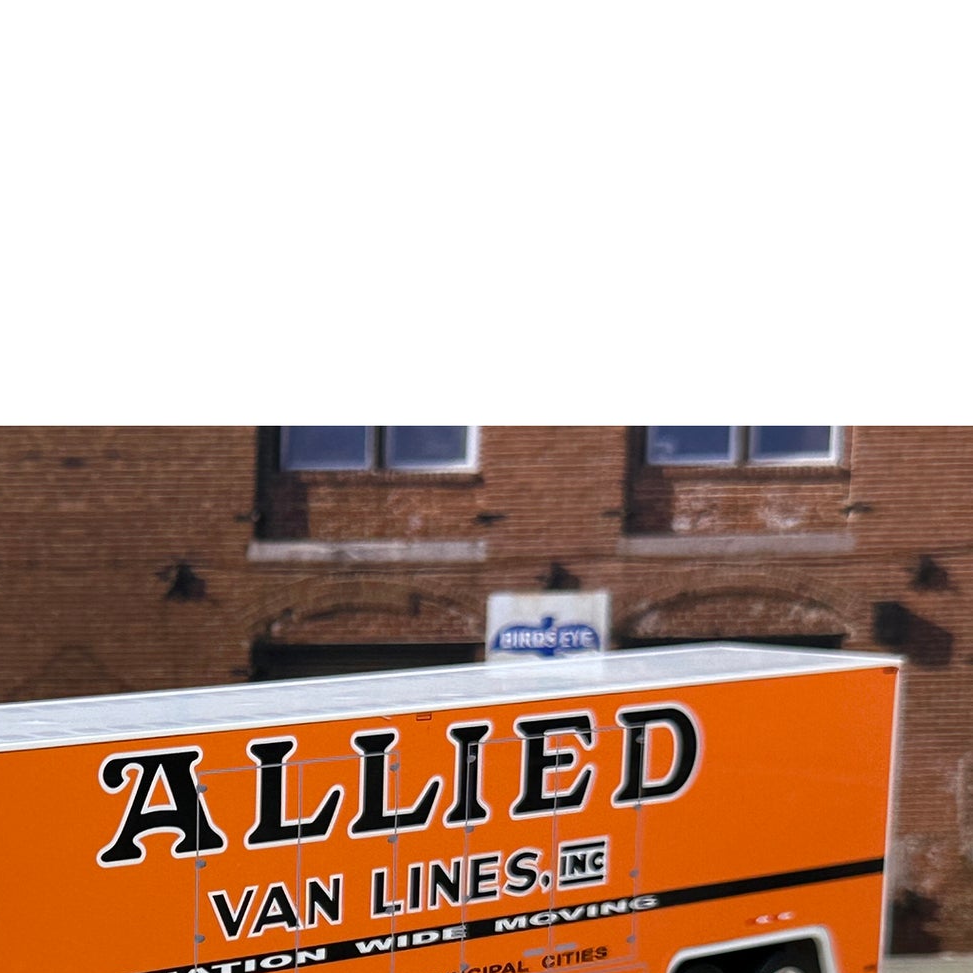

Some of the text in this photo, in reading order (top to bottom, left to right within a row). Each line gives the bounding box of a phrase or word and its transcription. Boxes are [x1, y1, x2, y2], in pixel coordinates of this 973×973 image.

[559, 631, 594, 648] EYE
[97, 702, 701, 867] ALLIED
[208, 873, 343, 943] VAN
[557, 836, 609, 889] INC
[354, 925, 468, 954] WIDE
[493, 895, 659, 932] MOVING
[542, 945, 608, 969] CITIES
